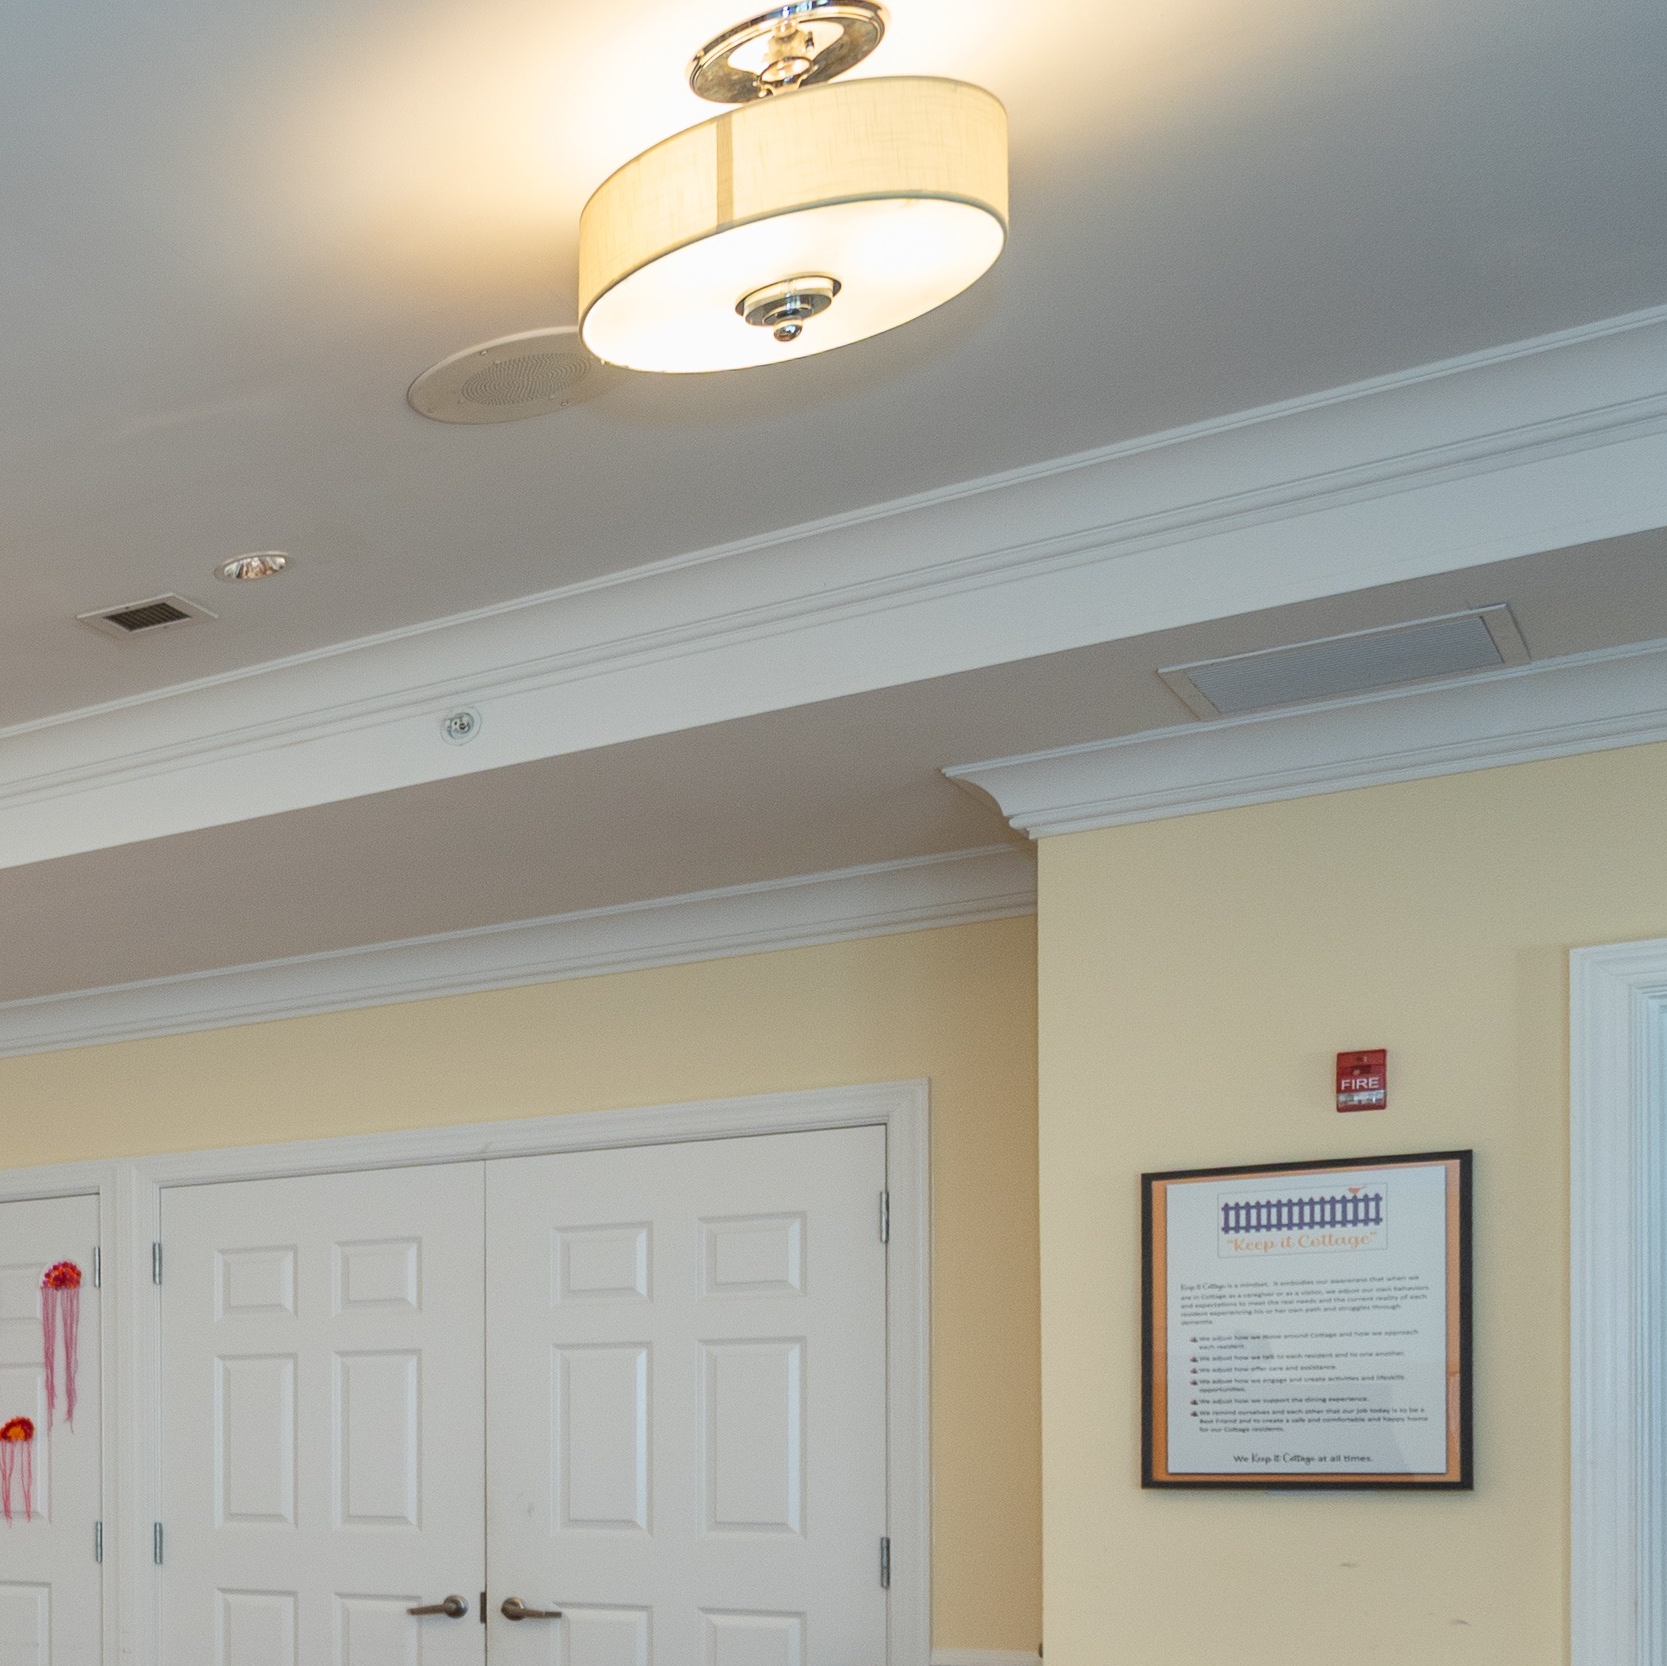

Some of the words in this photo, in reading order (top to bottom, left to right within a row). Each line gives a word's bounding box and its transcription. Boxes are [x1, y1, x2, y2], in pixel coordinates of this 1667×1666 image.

[1341, 1077, 1379, 1090] FIRE
[1280, 1235, 1293, 1249] it
[1233, 1455, 1249, 1463] We
[1329, 1454, 1341, 1463] all
